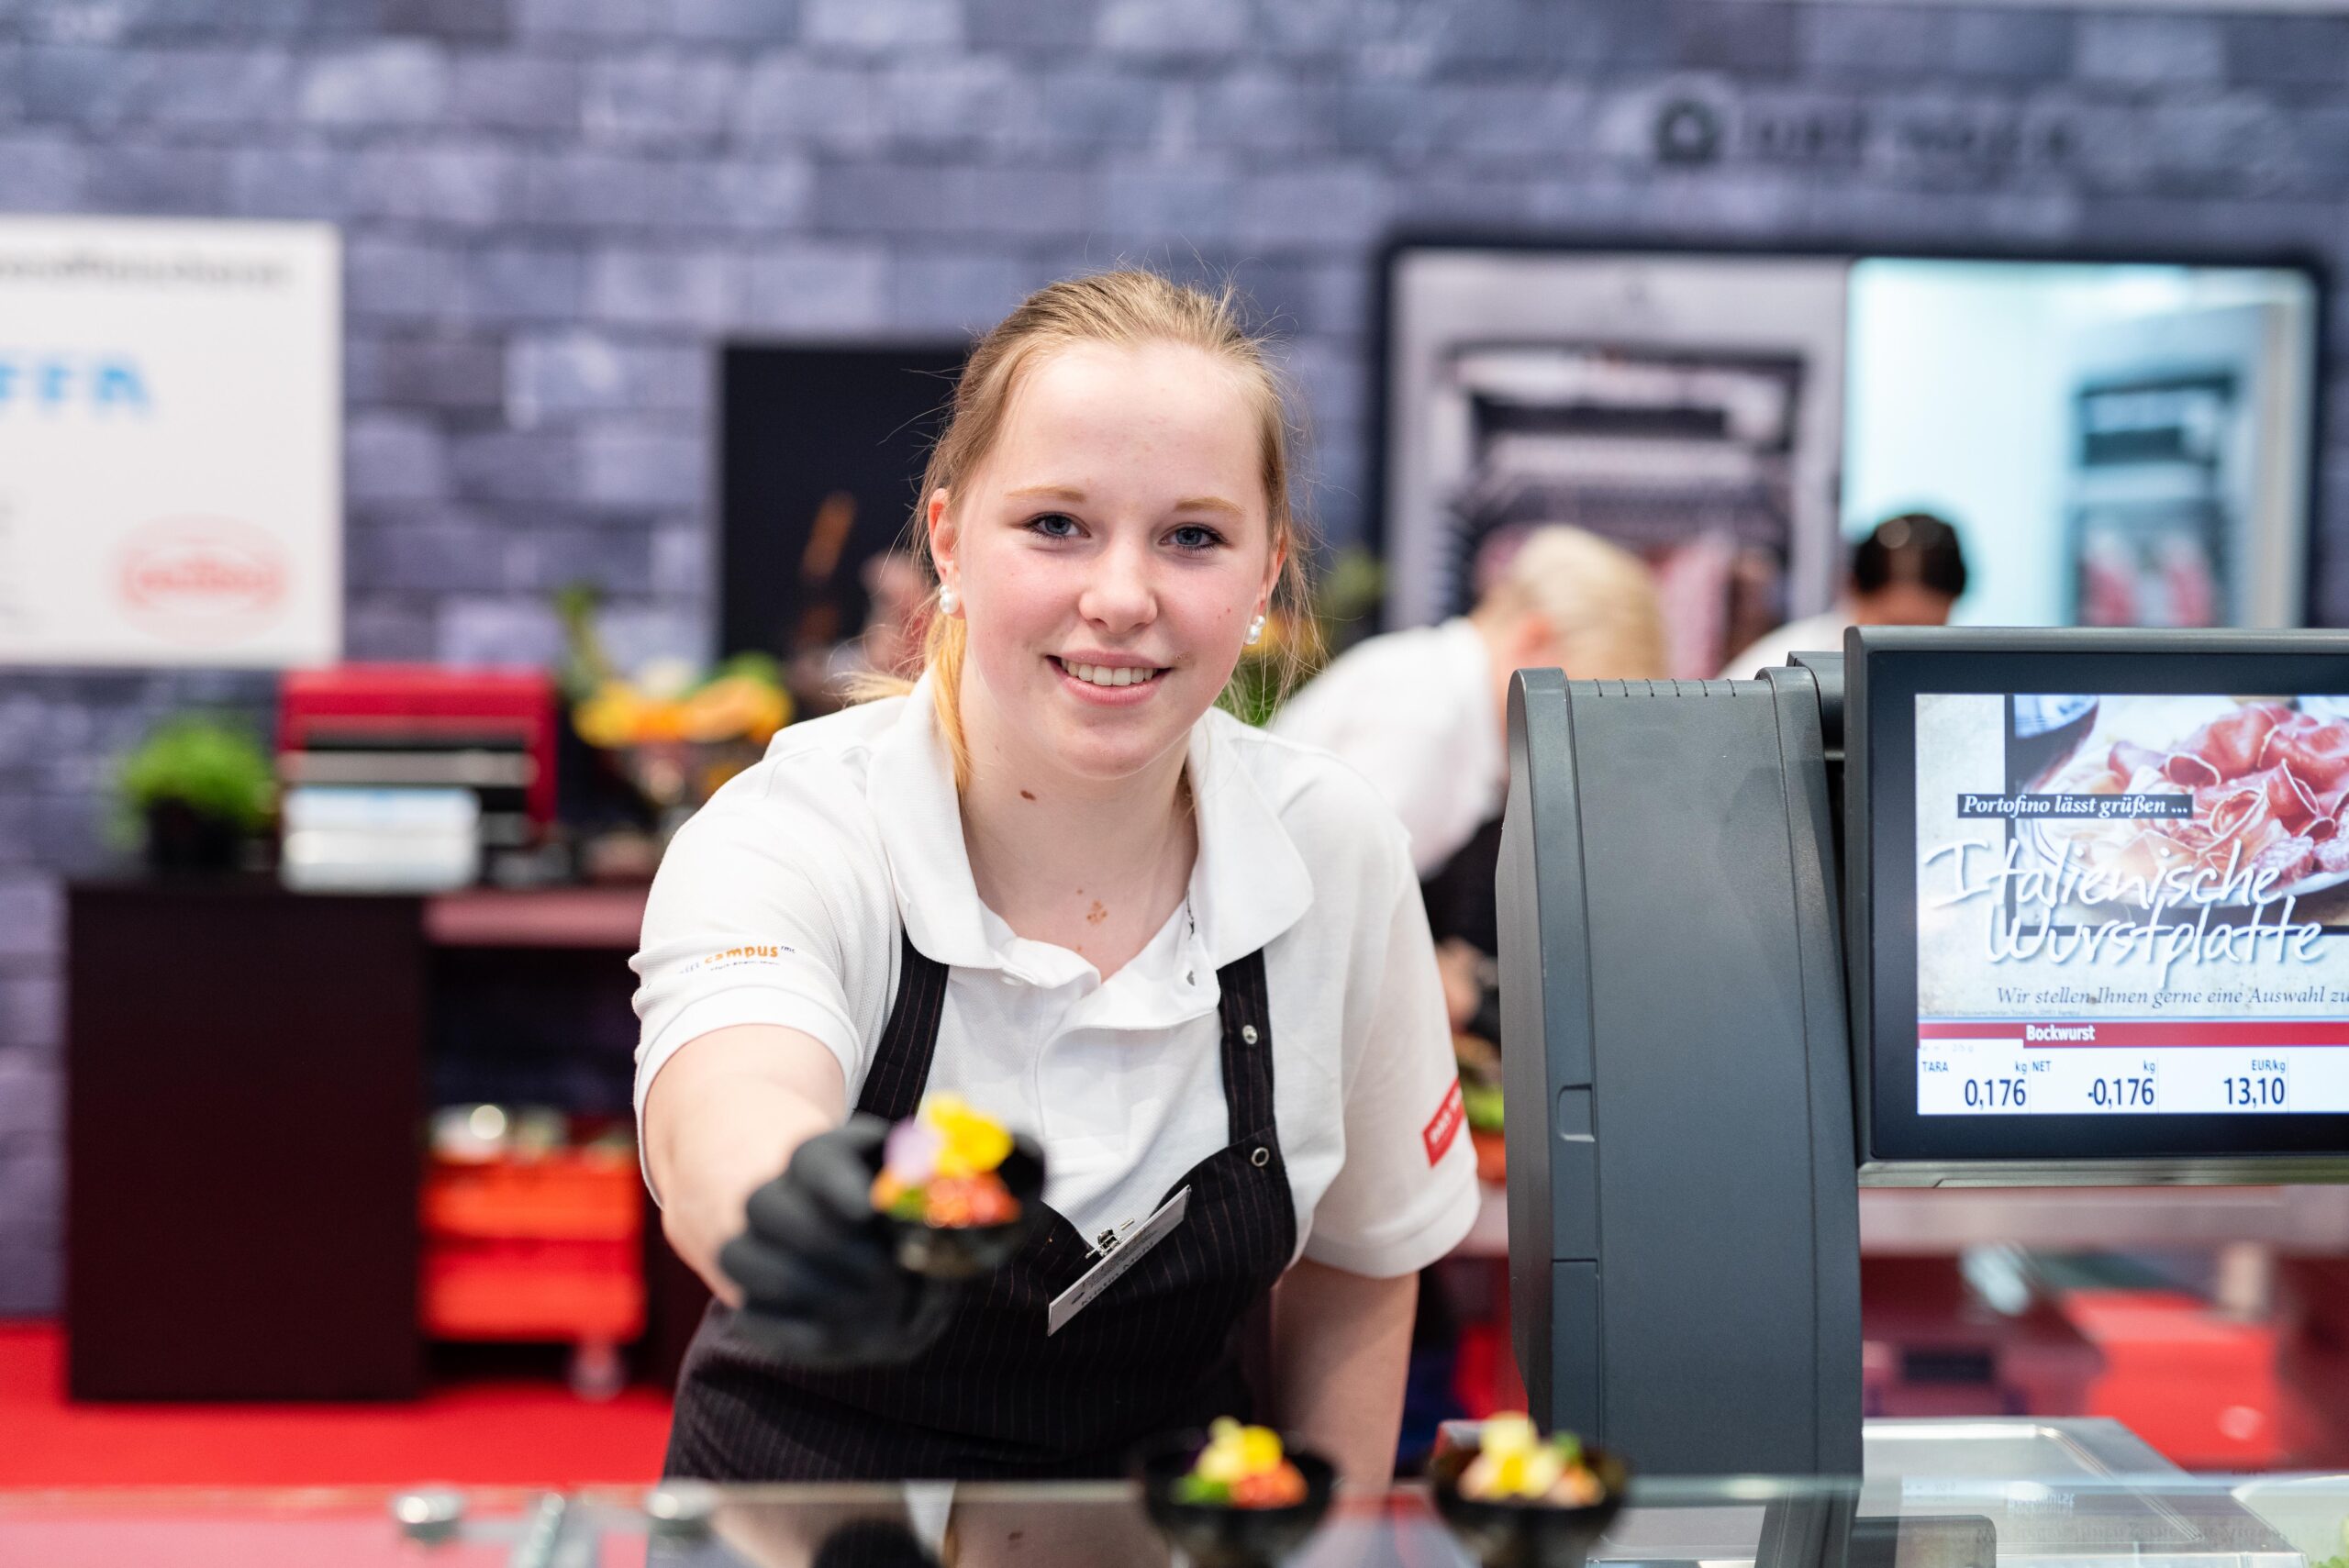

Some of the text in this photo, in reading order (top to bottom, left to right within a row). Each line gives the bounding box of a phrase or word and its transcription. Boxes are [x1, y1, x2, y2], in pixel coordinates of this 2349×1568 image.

[1963, 795, 2051, 818] Portofino
[2054, 795, 2097, 814] lässt
[2099, 795, 2166, 818] grüßen
[1923, 838, 2284, 910] Italienische
[1983, 895, 2328, 989] Wurstplatte
[704, 945, 779, 964] campus
[1997, 986, 2030, 1004] Wir
[2035, 986, 2091, 1004] stellen
[2096, 986, 2148, 1004] Ihnen
[2152, 990, 2203, 1009] gerne
[2207, 987, 2243, 1004] eine
[2248, 985, 2325, 1004] Auswahl
[2025, 1024, 2096, 1041] Bockwurst
[1921, 1061, 2027, 1074] TARA kg
[2032, 1060, 2155, 1073] NET kg
[1965, 1078, 2027, 1110] 0,176
[2087, 1078, 2154, 1110] -0,176
[2223, 1077, 2286, 1109] 13,10
